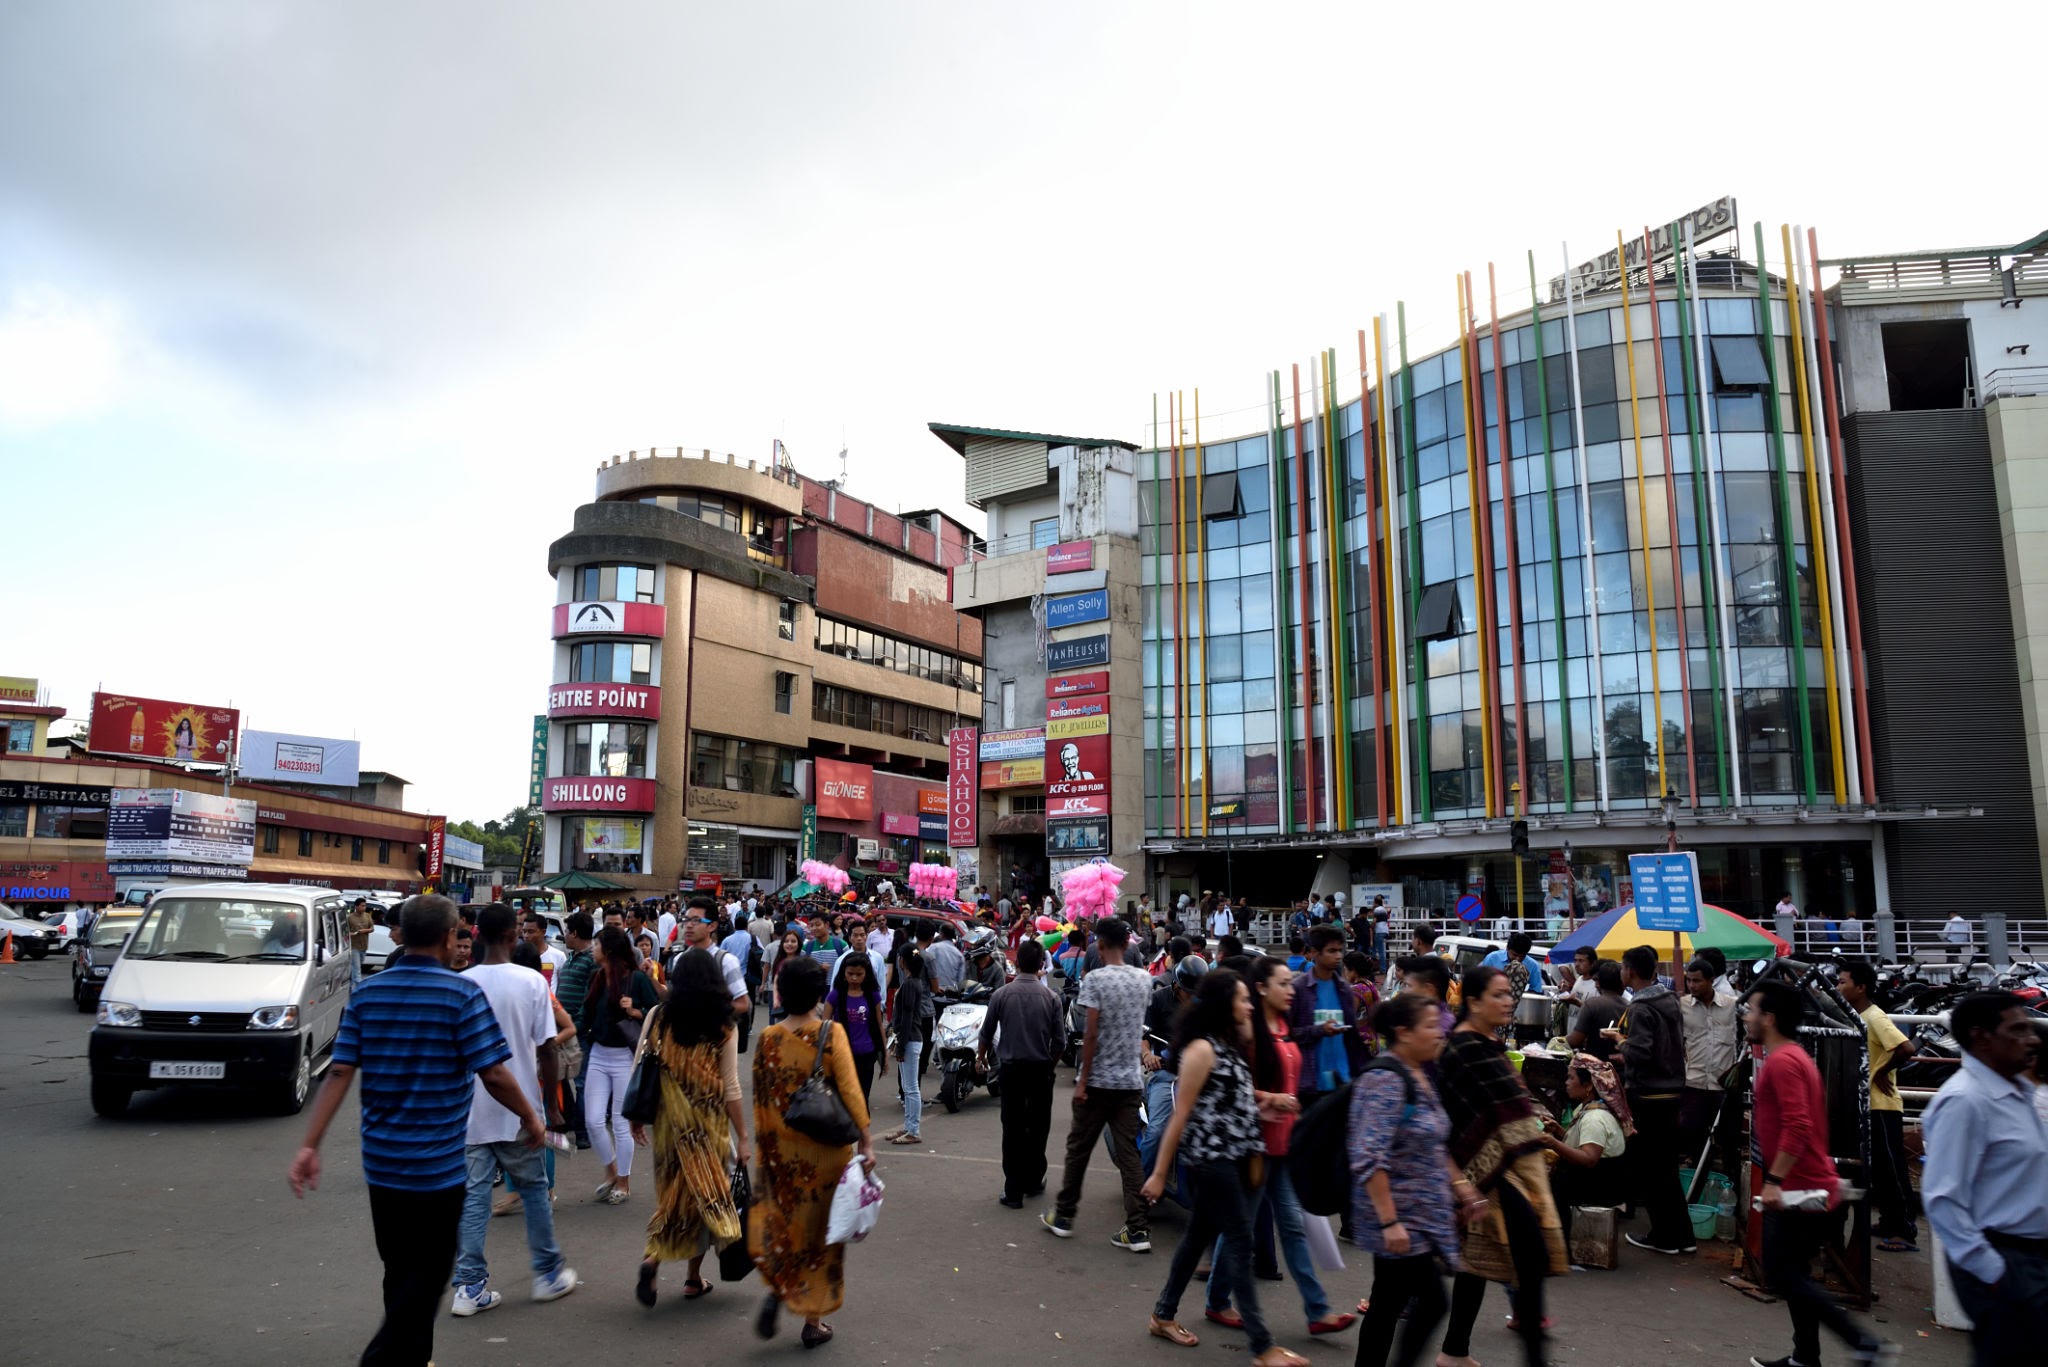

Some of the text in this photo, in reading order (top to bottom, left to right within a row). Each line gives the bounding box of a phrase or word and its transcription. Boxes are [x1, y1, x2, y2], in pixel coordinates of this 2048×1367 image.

[1050, 603, 1075, 615] Allen
[1077, 596, 1103, 611] Solly
[1050, 705, 1081, 718] Reliance
[982, 742, 1001, 750] CASIO
[278, 759, 321, 773] 9402303313
[954, 743, 971, 830] SHAHOO
[1049, 783, 1071, 794] KFC
[1078, 784, 1088, 792] 2ND
[1088, 783, 1105, 791] FLOOR
[23, 784, 110, 803] HERITAGE
[552, 784, 627, 803] SHILLONG
[1063, 797, 1089, 810] KFC
[1210, 803, 1238, 816] SUBWAY
[108, 864, 170, 873] SHILLONG TRAFFIC POLICE
[171, 864, 248, 878] SHILLONG TRAFFIC POLICE
